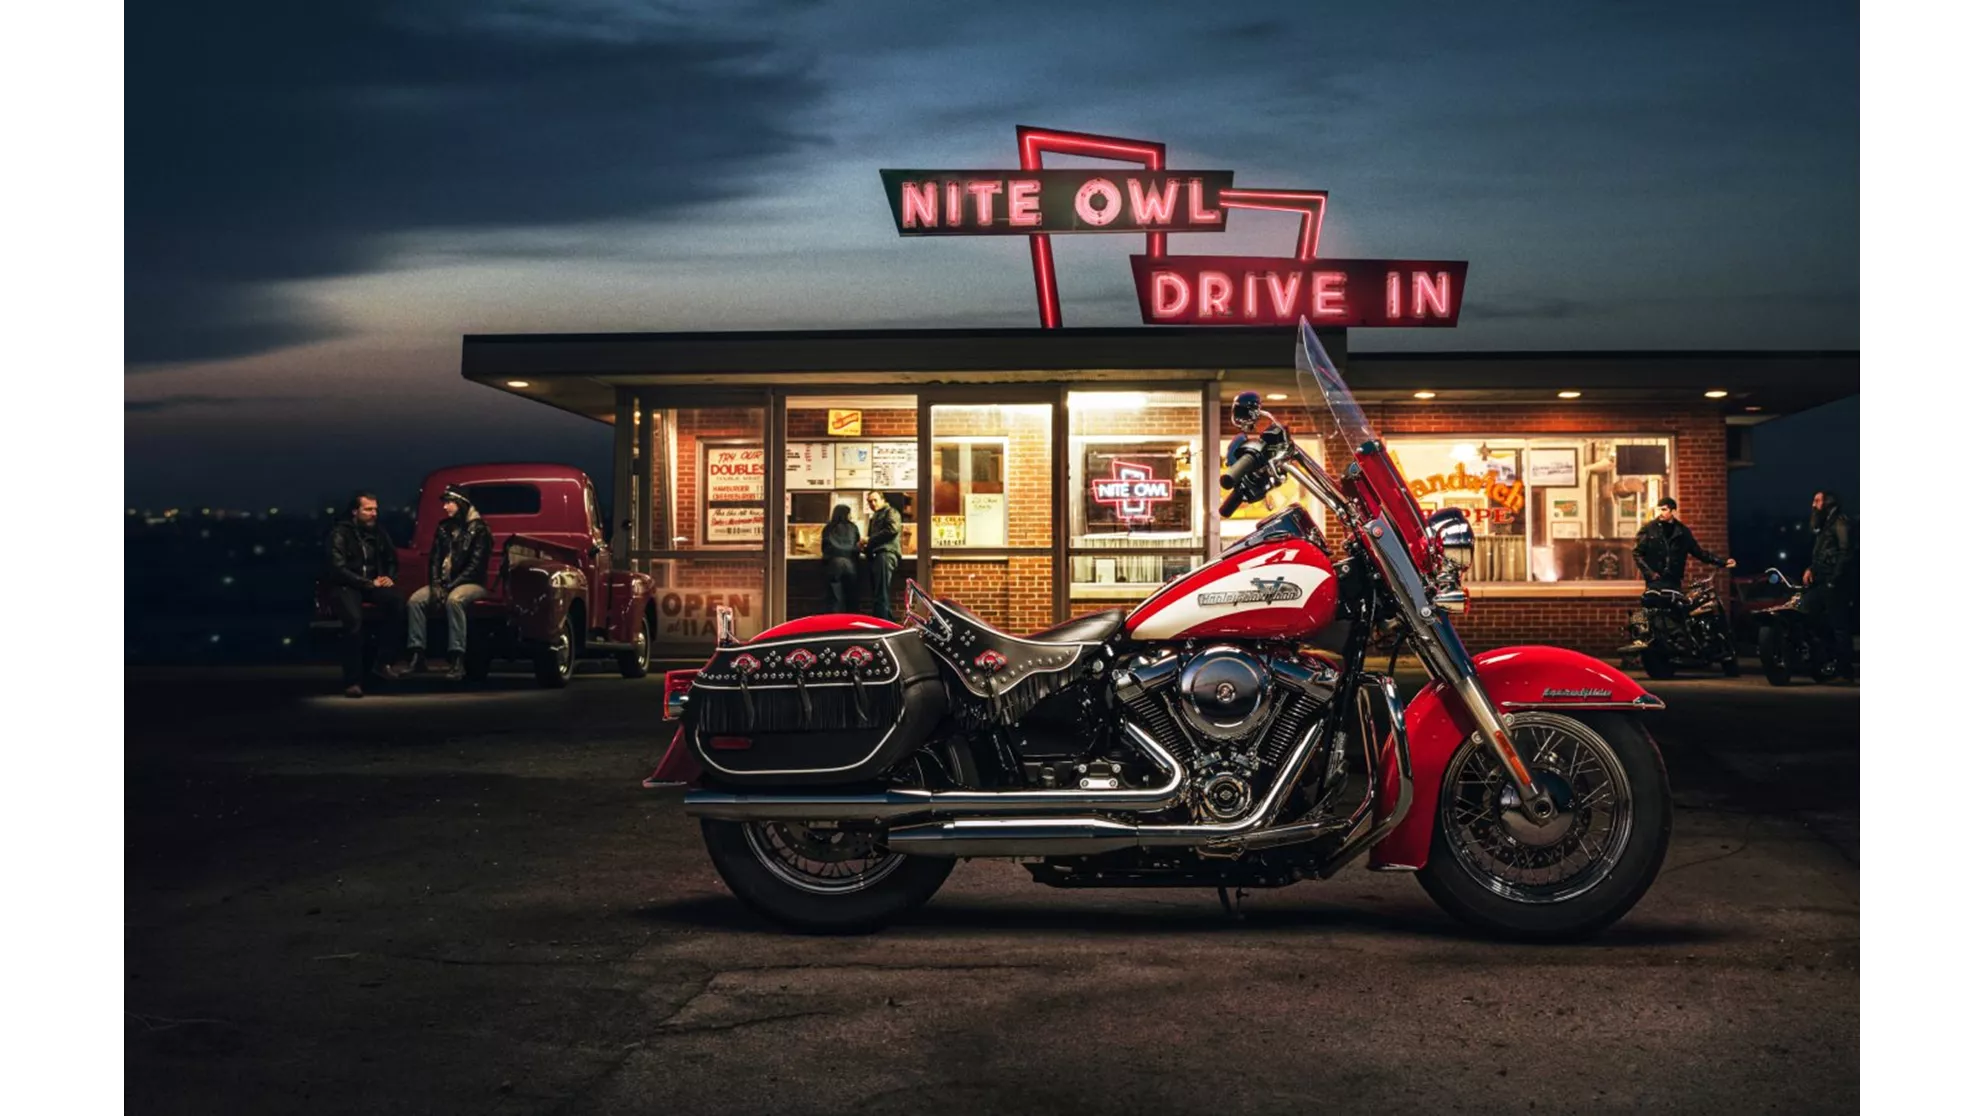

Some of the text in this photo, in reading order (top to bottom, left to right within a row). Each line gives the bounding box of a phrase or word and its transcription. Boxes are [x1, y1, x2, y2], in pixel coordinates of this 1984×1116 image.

[902, 177, 1222, 227] NITE OWL
[1151, 271, 1451, 318] DRIVE IN
[718, 450, 764, 463] TRY OUR
[710, 463, 767, 476] DOUBLES
[1098, 483, 1169, 498] NITE OWL
[1409, 462, 1525, 514] andwich
[662, 593, 750, 618] OPEN
